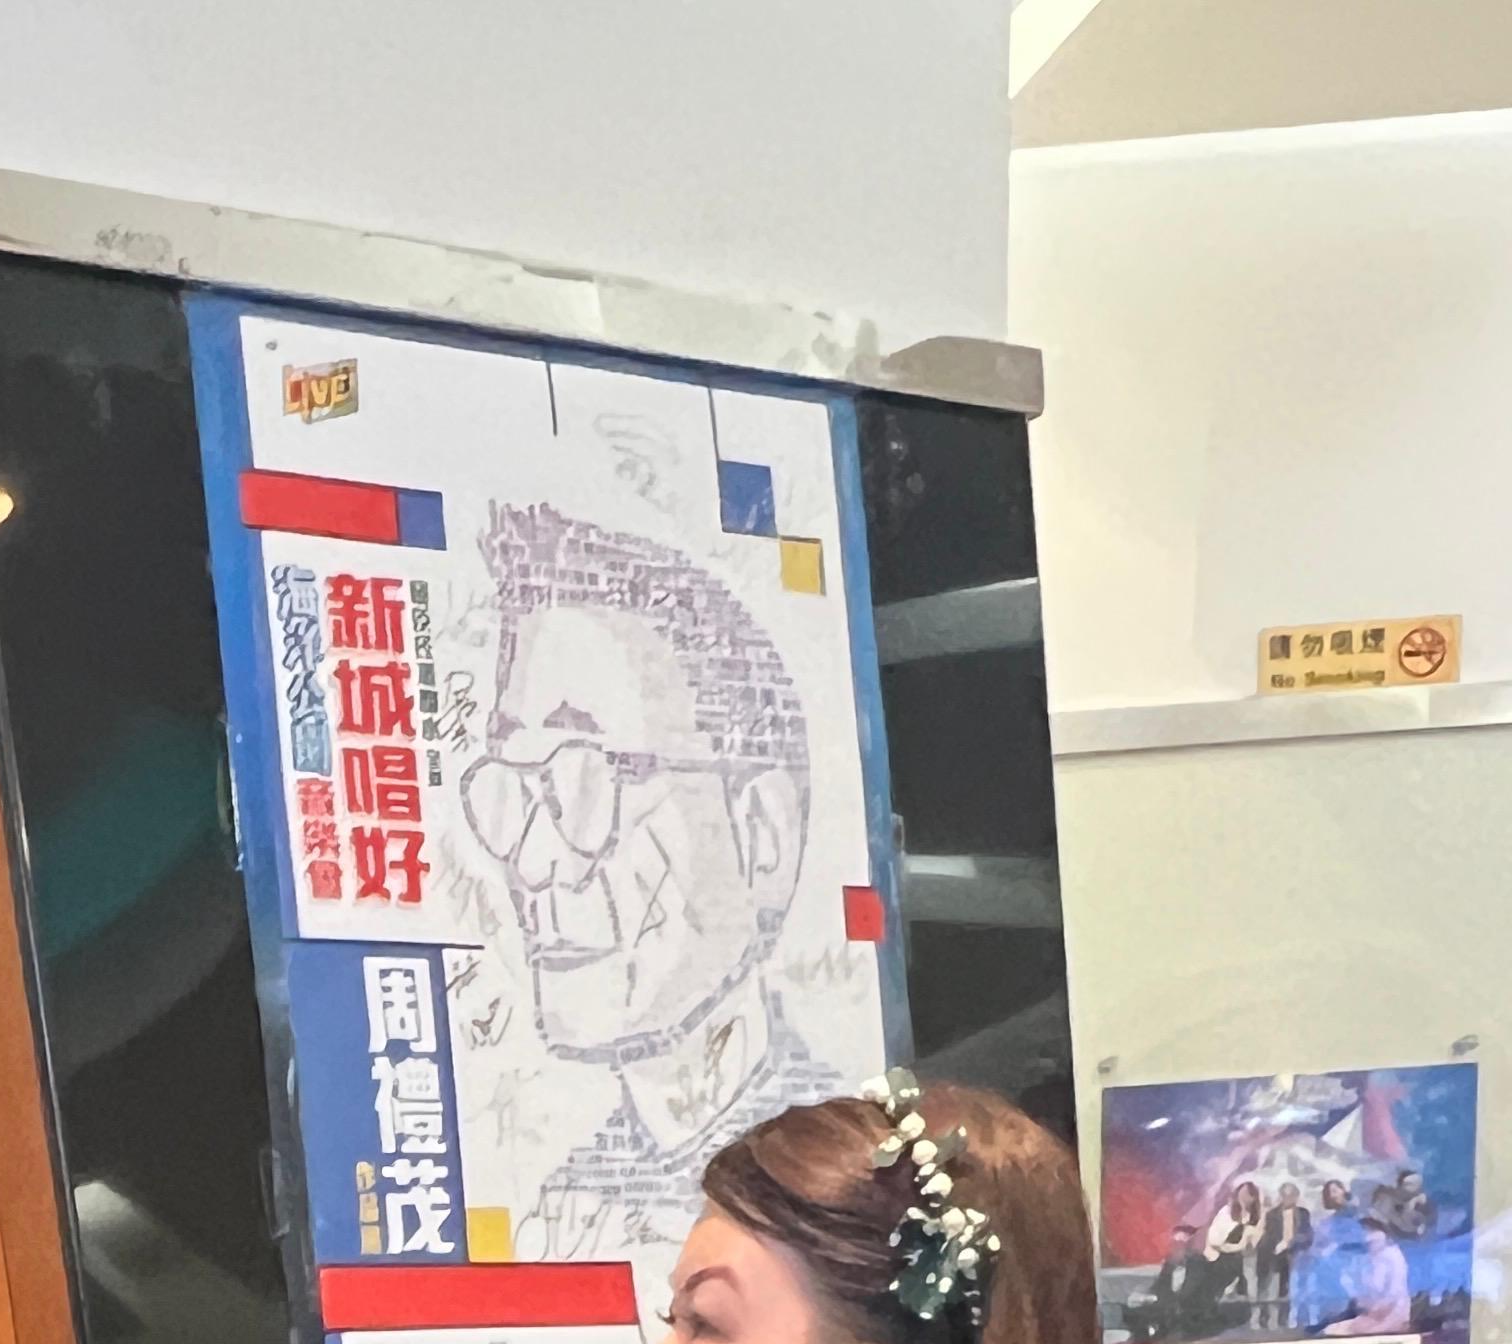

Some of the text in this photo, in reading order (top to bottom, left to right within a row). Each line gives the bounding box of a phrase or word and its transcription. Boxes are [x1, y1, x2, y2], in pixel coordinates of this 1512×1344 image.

[326, 574, 431, 903] 新城唱好
[363, 956, 455, 1253] 周禮茂
